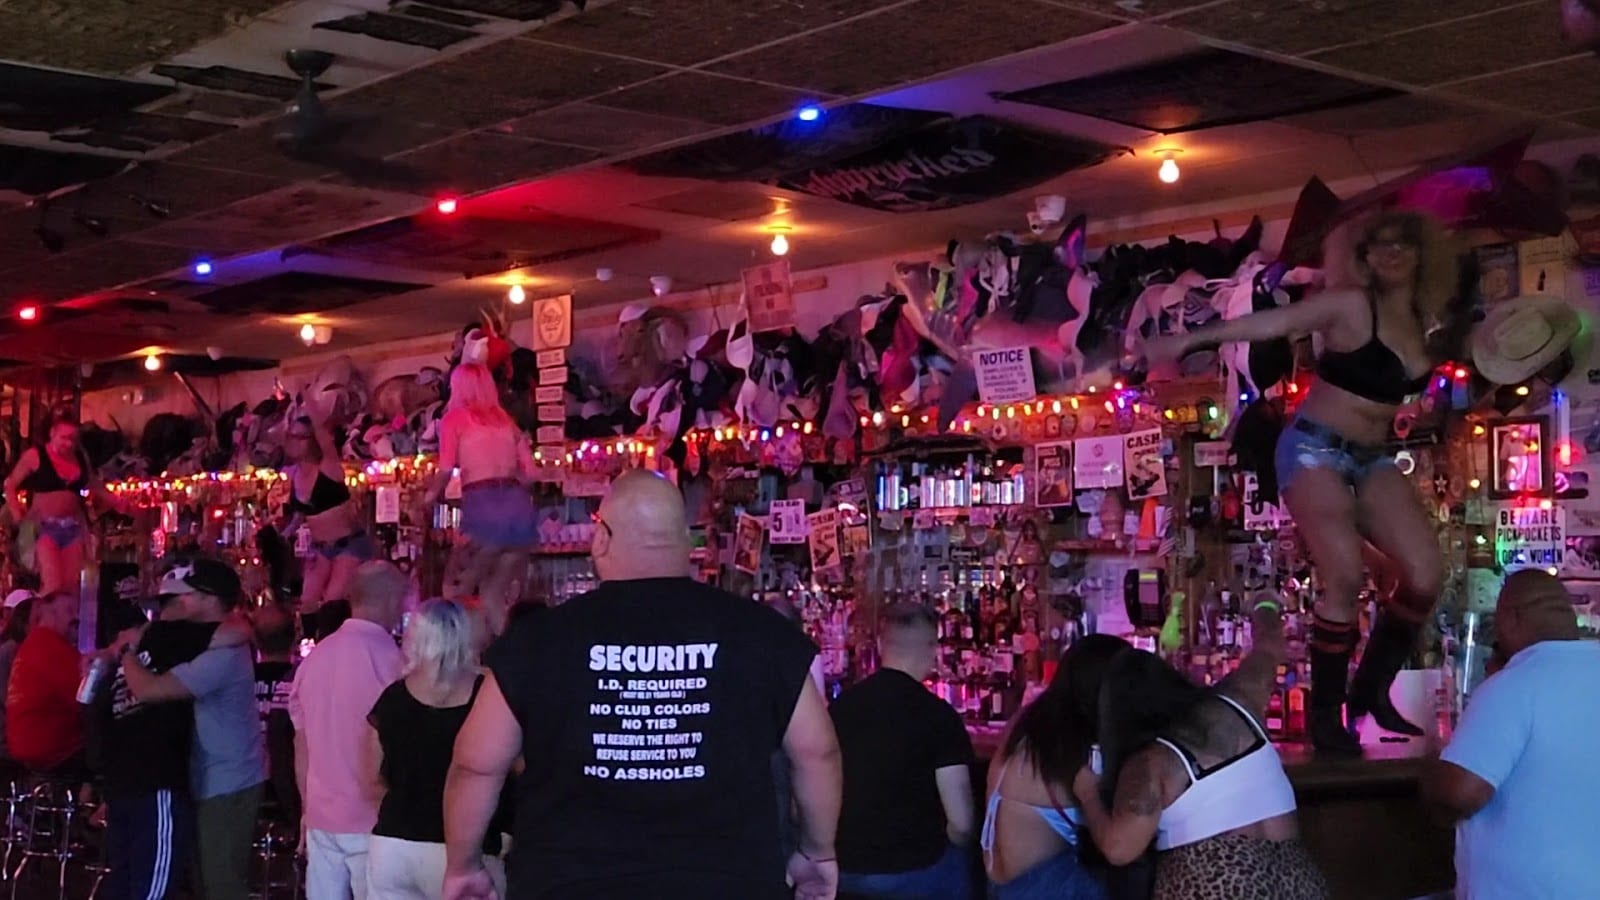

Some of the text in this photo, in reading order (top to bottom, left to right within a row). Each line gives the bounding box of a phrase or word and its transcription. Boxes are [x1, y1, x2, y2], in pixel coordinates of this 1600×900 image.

[980, 348, 1024, 366] NOTICE
[1127, 433, 1160, 449] CASH
[1497, 526, 1561, 543] PICKPOCKETS
[1529, 548, 1563, 564] WOMEN
[589, 643, 718, 672] SECURITY
[598, 677, 707, 691] I.D. REQUIRED
[590, 703, 711, 715] NO CLUB COLORS
[622, 718, 677, 730] NO TIES
[593, 732, 702, 746] WE RESERVE THE RIGHT TO
[596, 747, 697, 761] REFUSE SERVICE TO YOU
[584, 765, 705, 780] NO ASSHOLES
